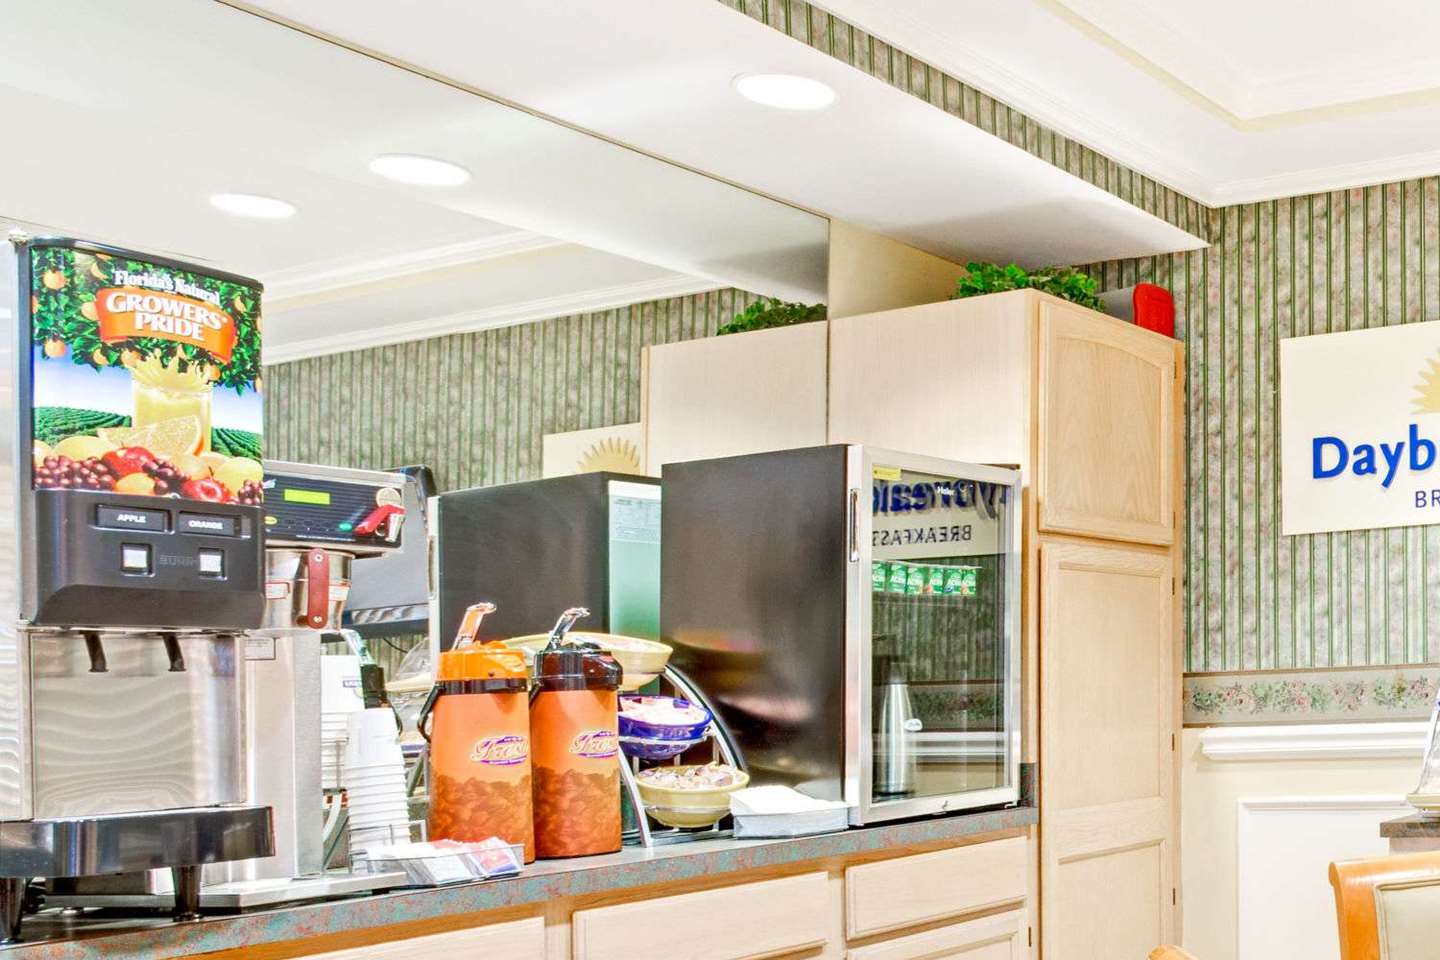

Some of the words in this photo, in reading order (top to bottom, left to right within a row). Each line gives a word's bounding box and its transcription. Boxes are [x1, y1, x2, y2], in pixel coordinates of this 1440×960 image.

[174, 278, 220, 305] Natural
[135, 312, 205, 341] PRIDE
[116, 513, 146, 523] APPLE
[188, 519, 223, 530] ORANGE
